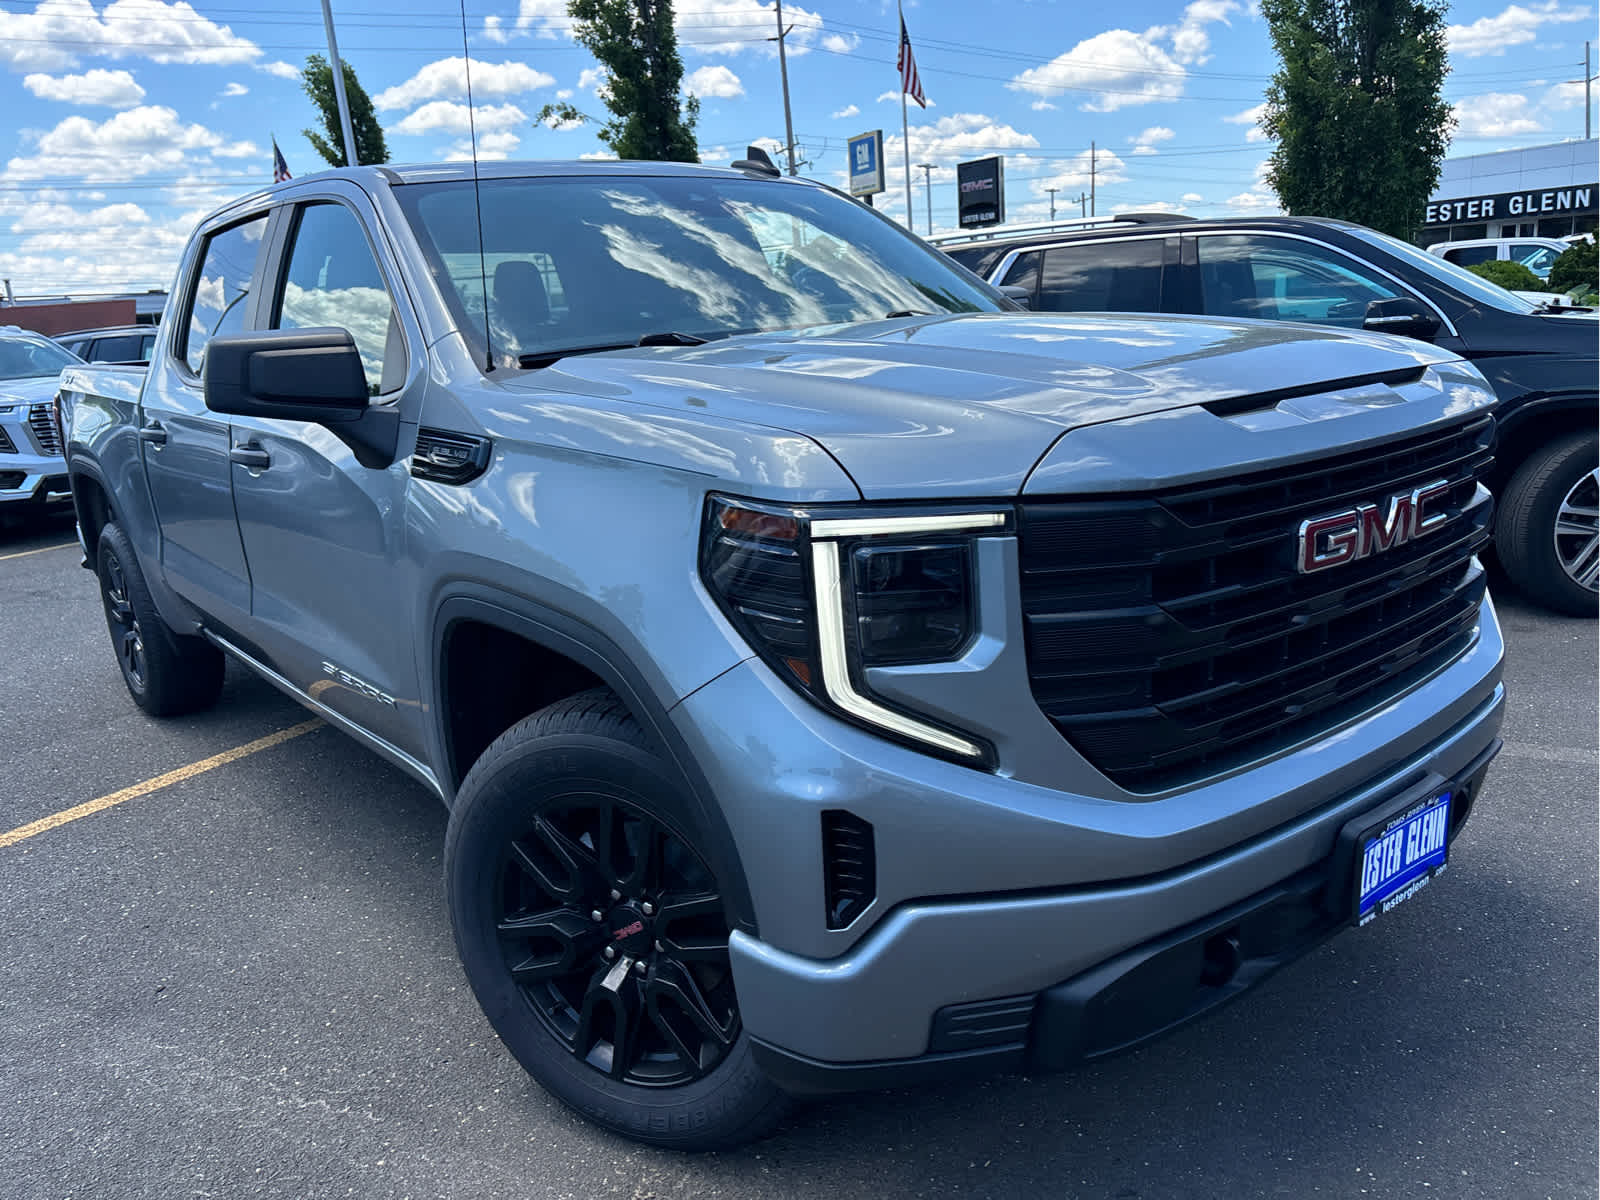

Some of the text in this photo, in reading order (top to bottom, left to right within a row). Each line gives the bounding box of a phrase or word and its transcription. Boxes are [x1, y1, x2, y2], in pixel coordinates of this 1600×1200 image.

[961, 178, 993, 193] GMC
[1426, 188, 1592, 223] ESTER GLENN
[1298, 479, 1449, 574] GMC
[1360, 804, 1448, 897] LESTER GLENN
